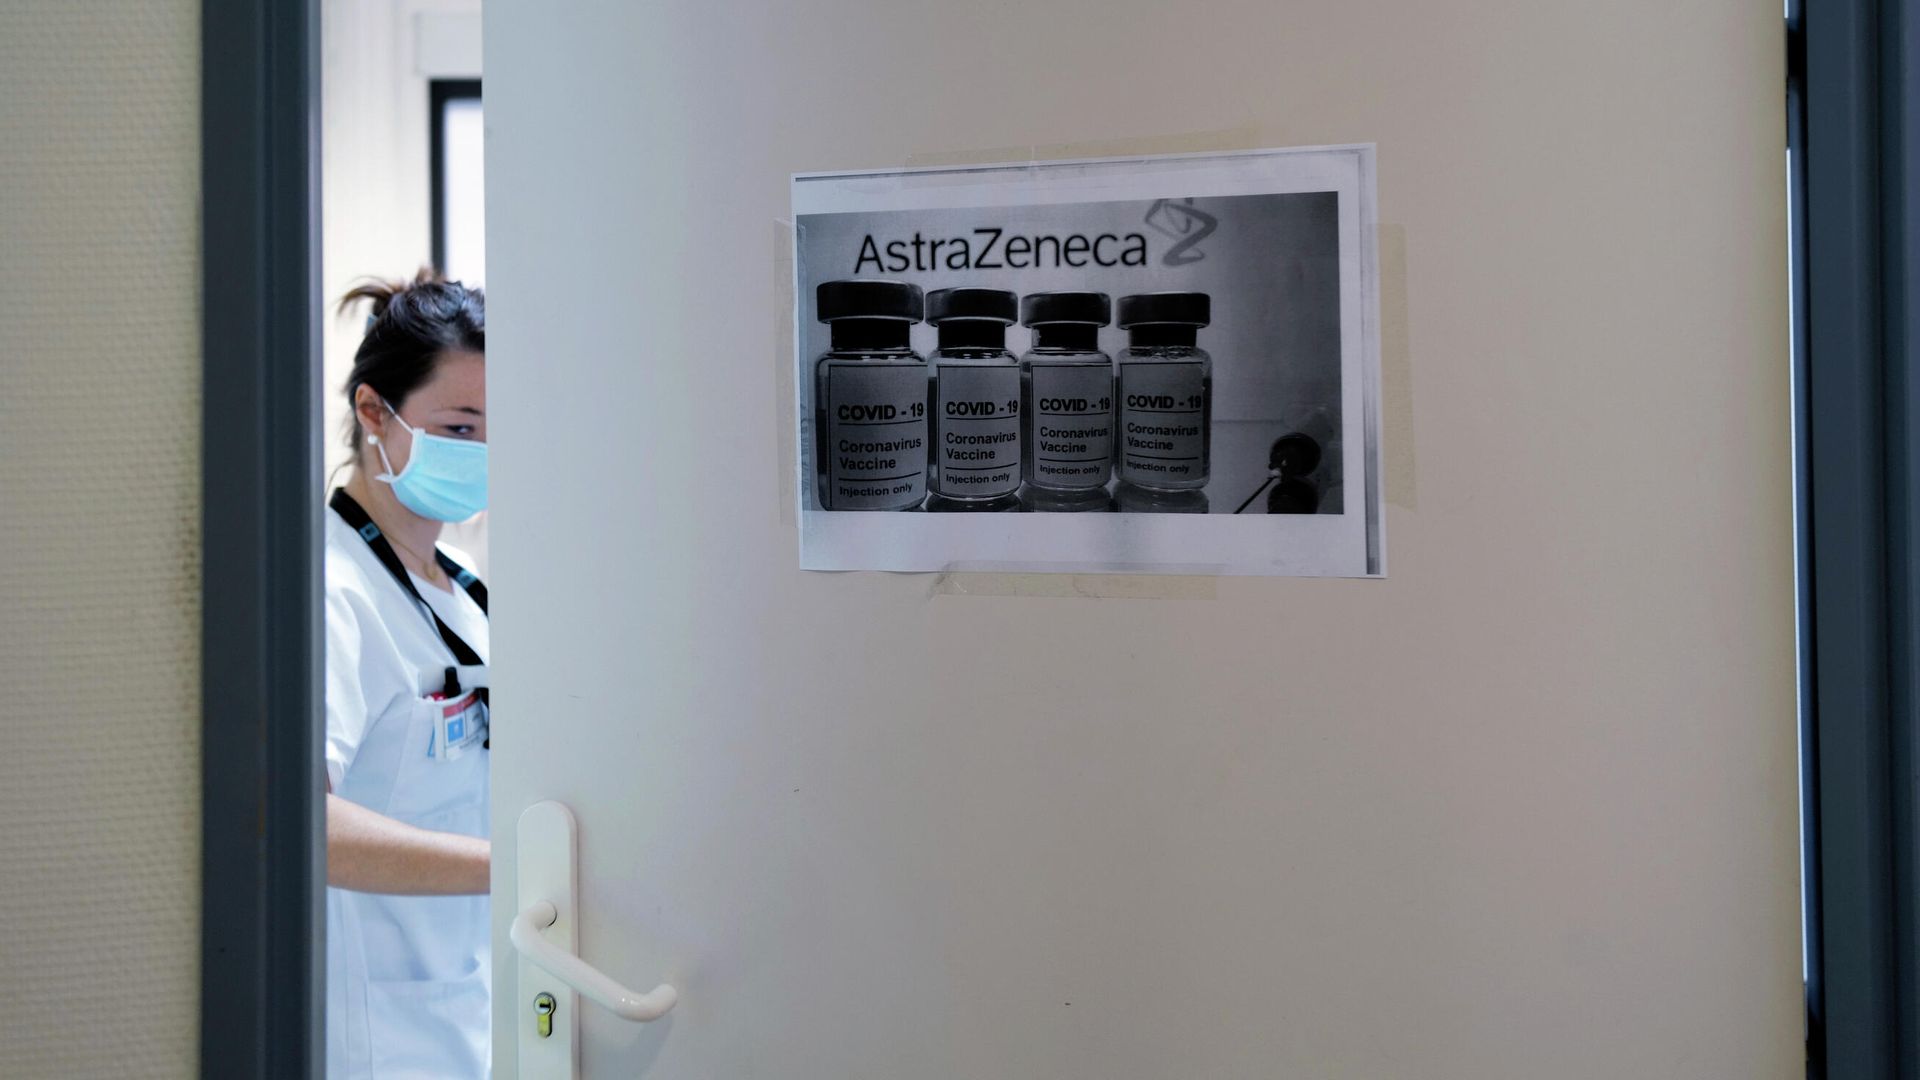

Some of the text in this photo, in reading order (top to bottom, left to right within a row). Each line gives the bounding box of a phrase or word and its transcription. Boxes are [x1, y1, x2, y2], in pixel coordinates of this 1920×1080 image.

[854, 228, 1147, 274] AstraZeneca
[946, 401, 996, 416] COVID
[1007, 400, 1018, 414] 19
[1039, 398, 1088, 412] COVID
[1098, 397, 1111, 410] 19
[1127, 394, 1175, 409] COVID
[1189, 395, 1202, 408] 19
[838, 404, 897, 421] COVID
[910, 402, 924, 417] 19
[1040, 426, 1109, 439] Coronavirus
[1127, 422, 1199, 436] Coronavirus
[839, 437, 922, 453] Coronavirus
[946, 431, 1017, 445] Coronavirus
[1127, 436, 1174, 450] Vaccine
[946, 447, 996, 460] Vaccine
[1040, 440, 1087, 453] Vaccine
[839, 457, 896, 471] Vaccine
[1039, 464, 1101, 475] Injection only
[1126, 459, 1190, 474] Injection only
[946, 472, 1011, 485] Injection only
[839, 482, 913, 498] Injection only
